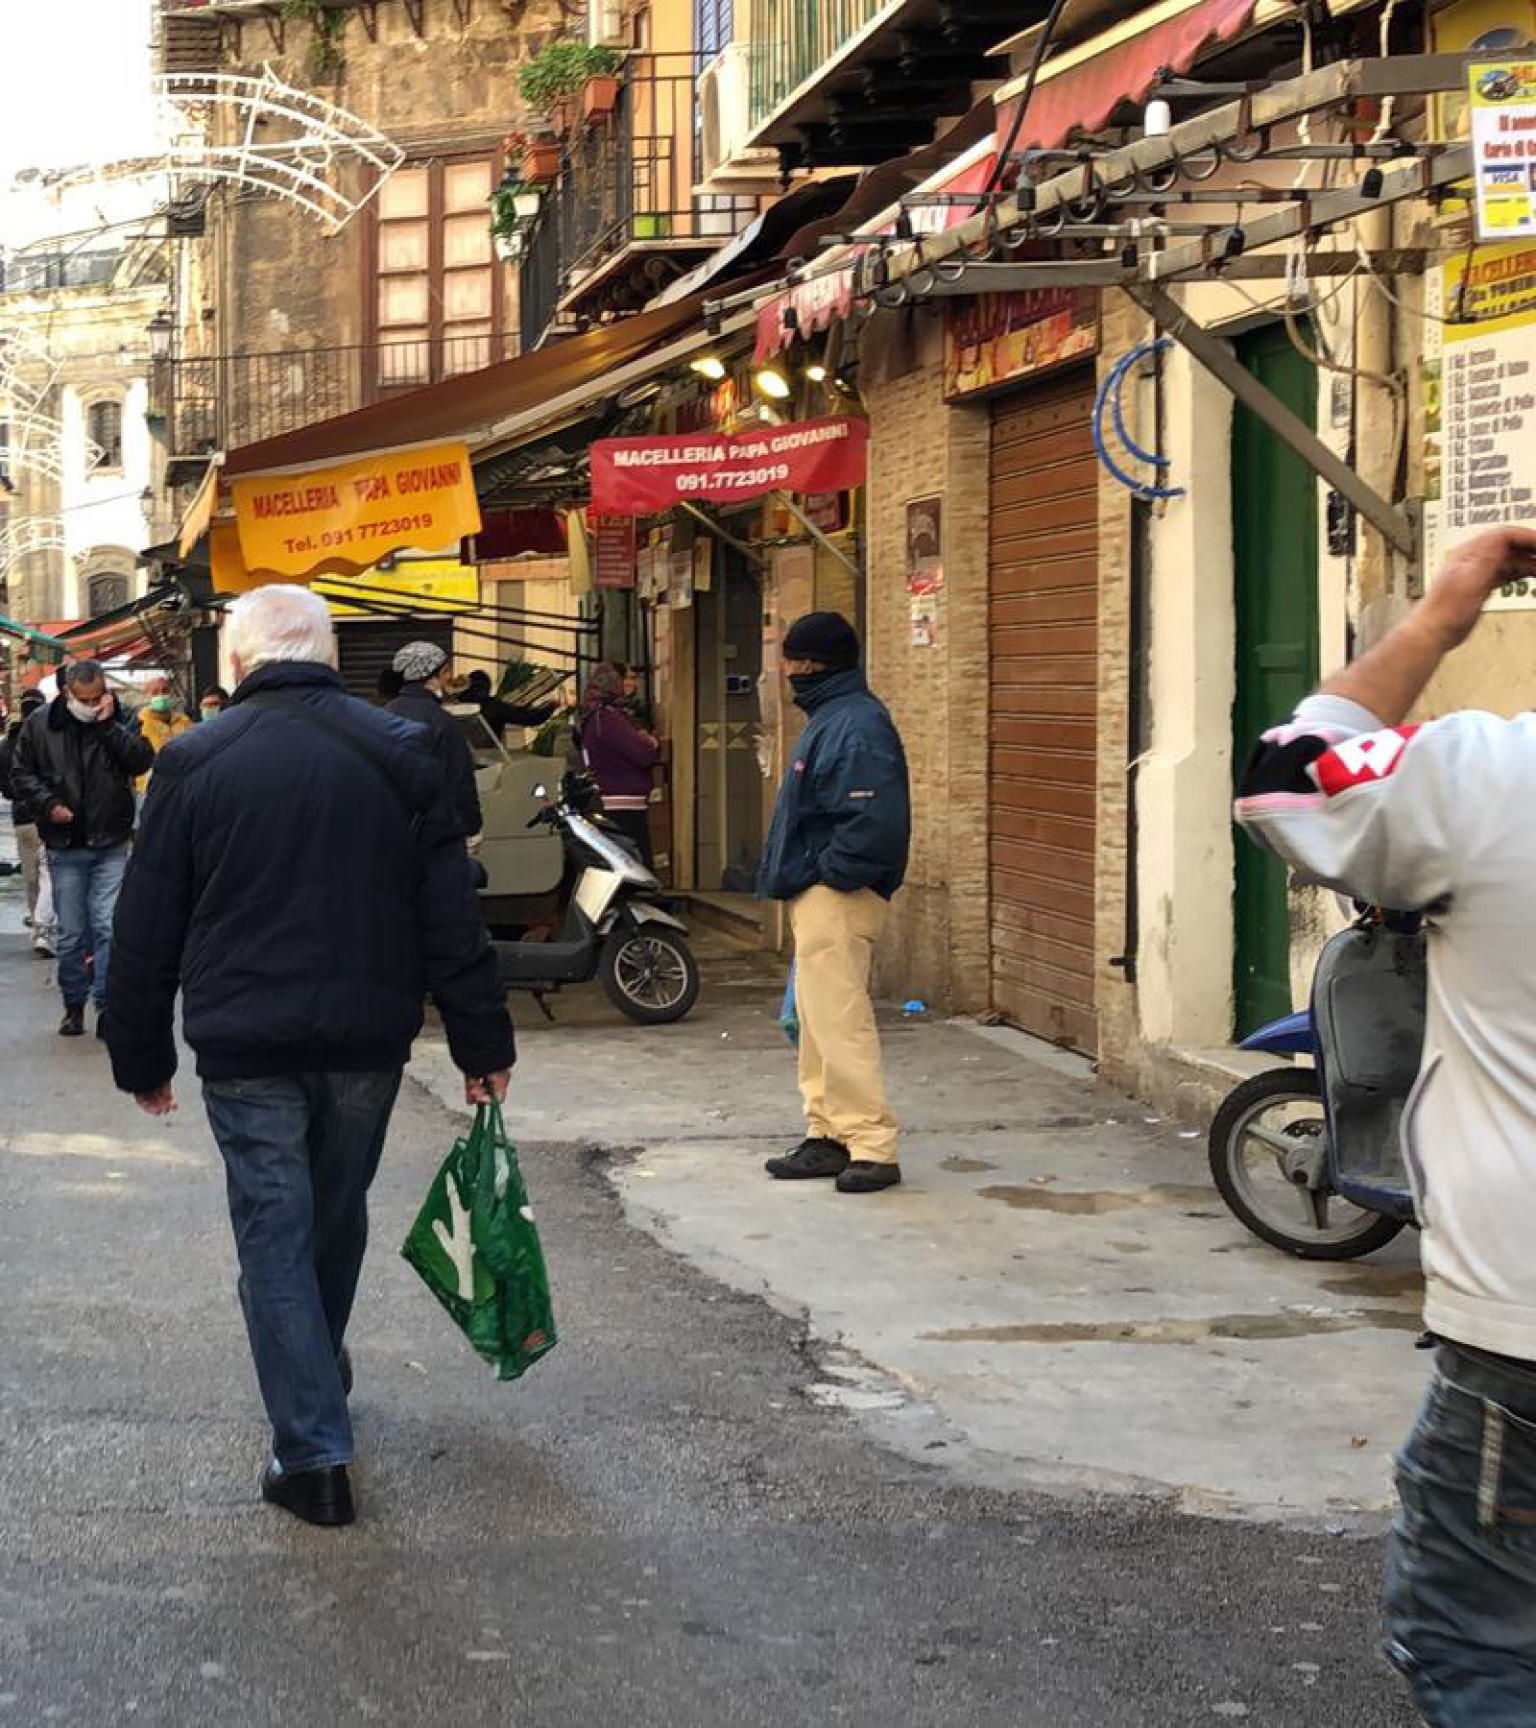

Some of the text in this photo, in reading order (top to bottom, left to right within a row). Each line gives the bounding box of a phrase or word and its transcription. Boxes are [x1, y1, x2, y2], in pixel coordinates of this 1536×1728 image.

[1492, 170, 1519, 185] VISA
[613, 422, 850, 467] MACELLERIA PAPA GIOVANNI
[252, 484, 341, 519] MACELLERIA
[396, 461, 462, 495] GIOVANNI
[675, 463, 790, 491] 091.7723019
[283, 512, 434, 555] Tel. 091 7723019
